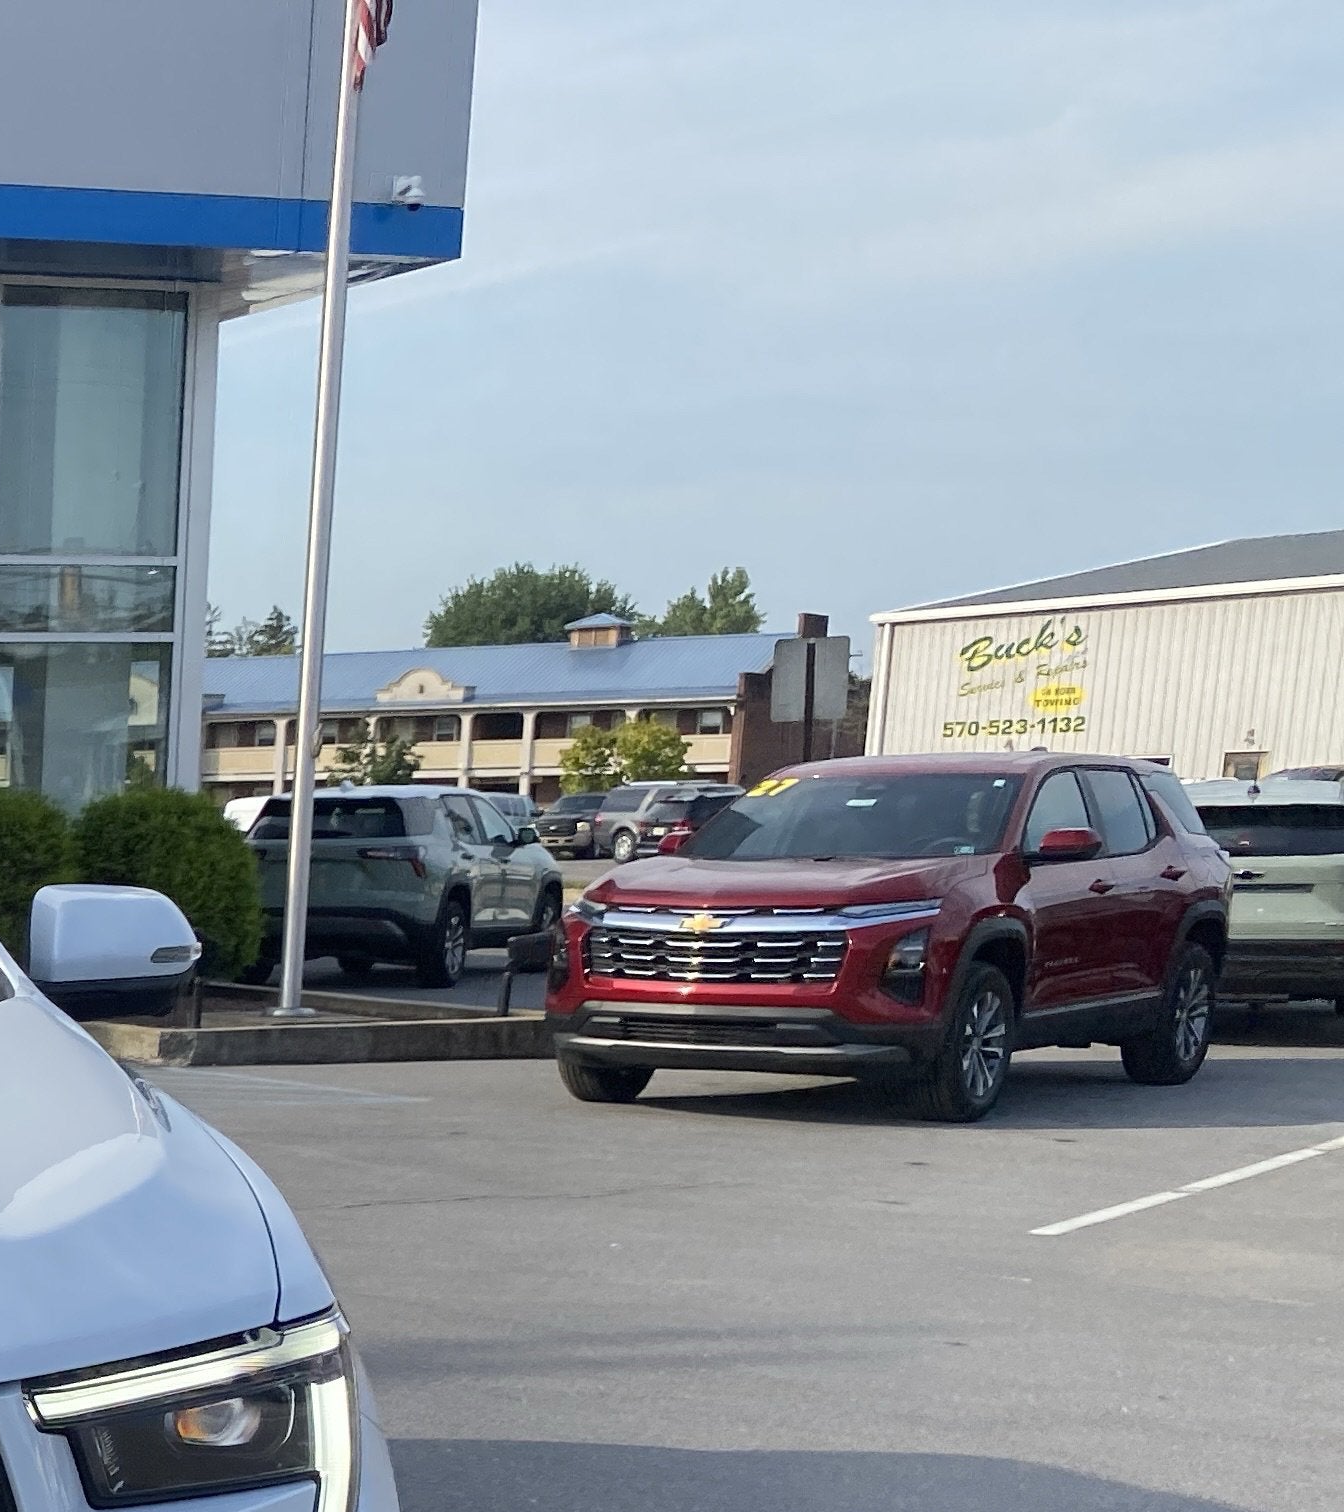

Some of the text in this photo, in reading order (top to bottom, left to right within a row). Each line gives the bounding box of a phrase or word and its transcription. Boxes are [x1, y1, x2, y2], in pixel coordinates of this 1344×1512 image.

[960, 616, 1088, 671] Buck's
[1035, 698, 1080, 708] TOWING
[942, 716, 1086, 738] 570-523-1132
